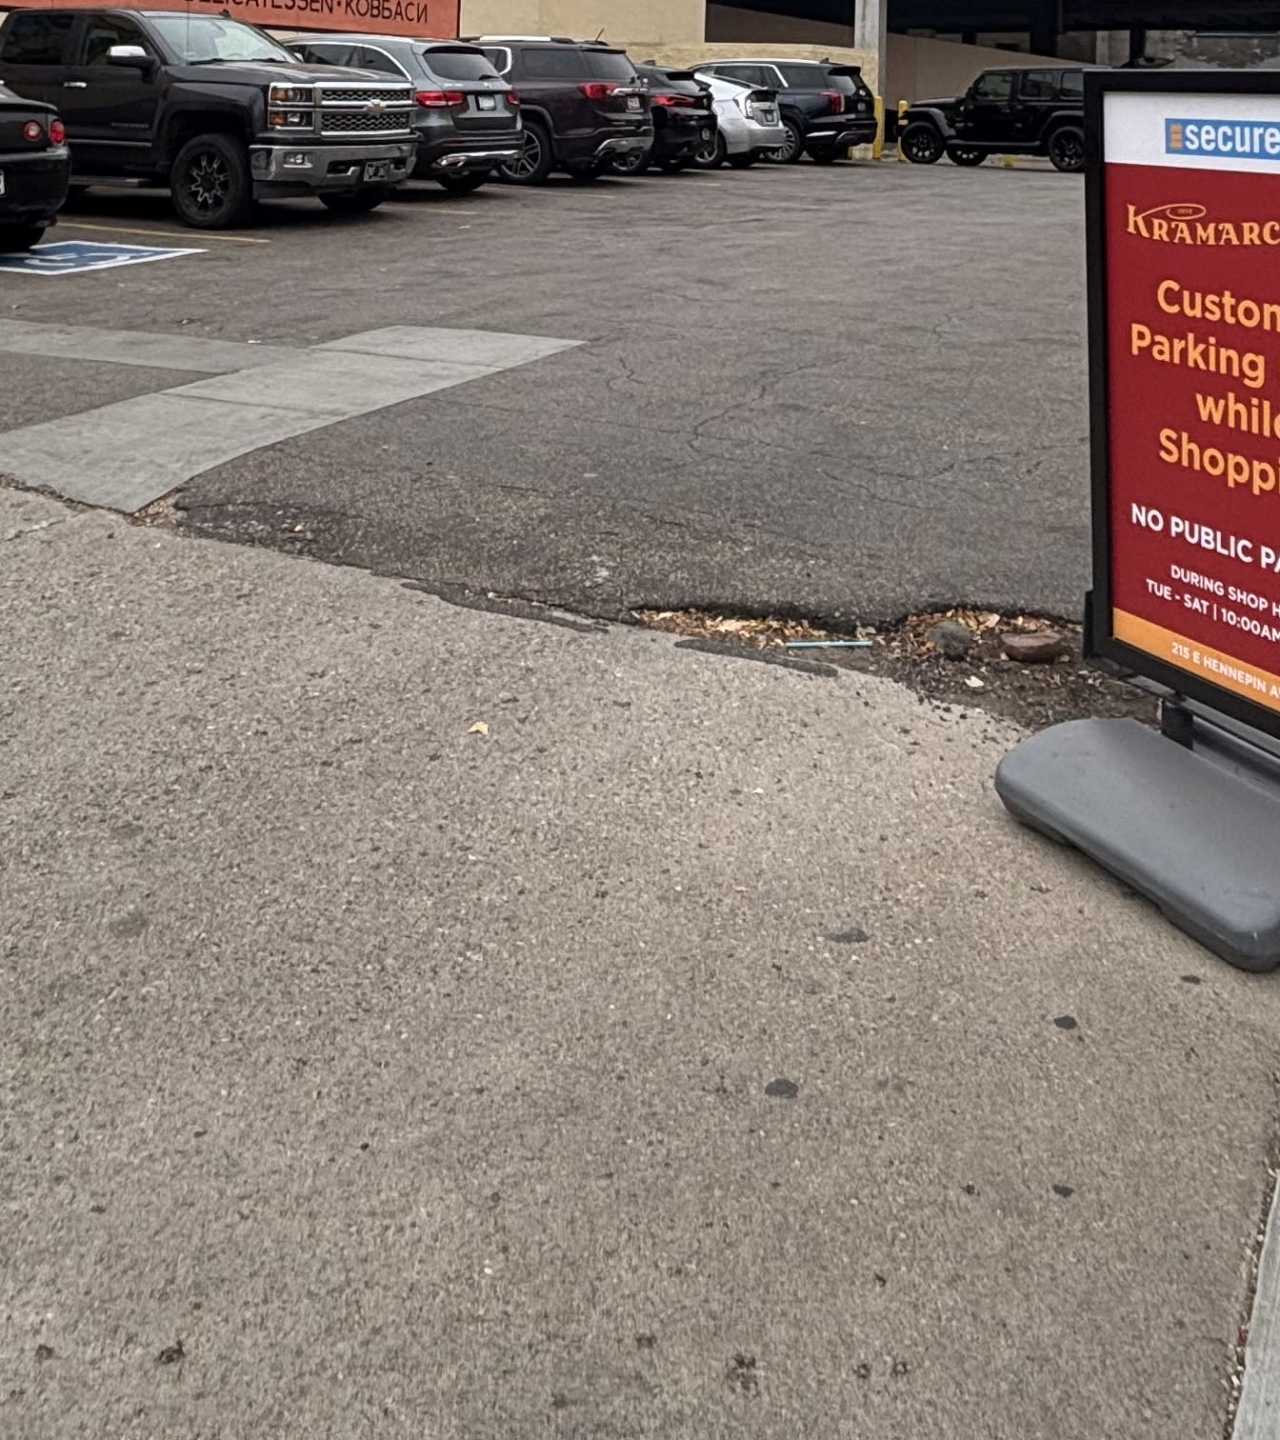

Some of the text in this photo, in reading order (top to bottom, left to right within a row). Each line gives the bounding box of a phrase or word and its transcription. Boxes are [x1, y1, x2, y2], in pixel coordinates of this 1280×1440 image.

[1131, 323, 1265, 389] Parking
[1131, 502, 1164, 532] NO
[1171, 516, 1253, 563] PUBLIC
[1146, 579, 1171, 600] TUE
[1184, 593, 1209, 615] SAT
[1171, 565, 1224, 596] DURING
[1228, 586, 1268, 612] SHOP
[1171, 641, 1190, 660] 215
[1193, 651, 1201, 665] E
[1203, 655, 1267, 694] HENNEPIN
